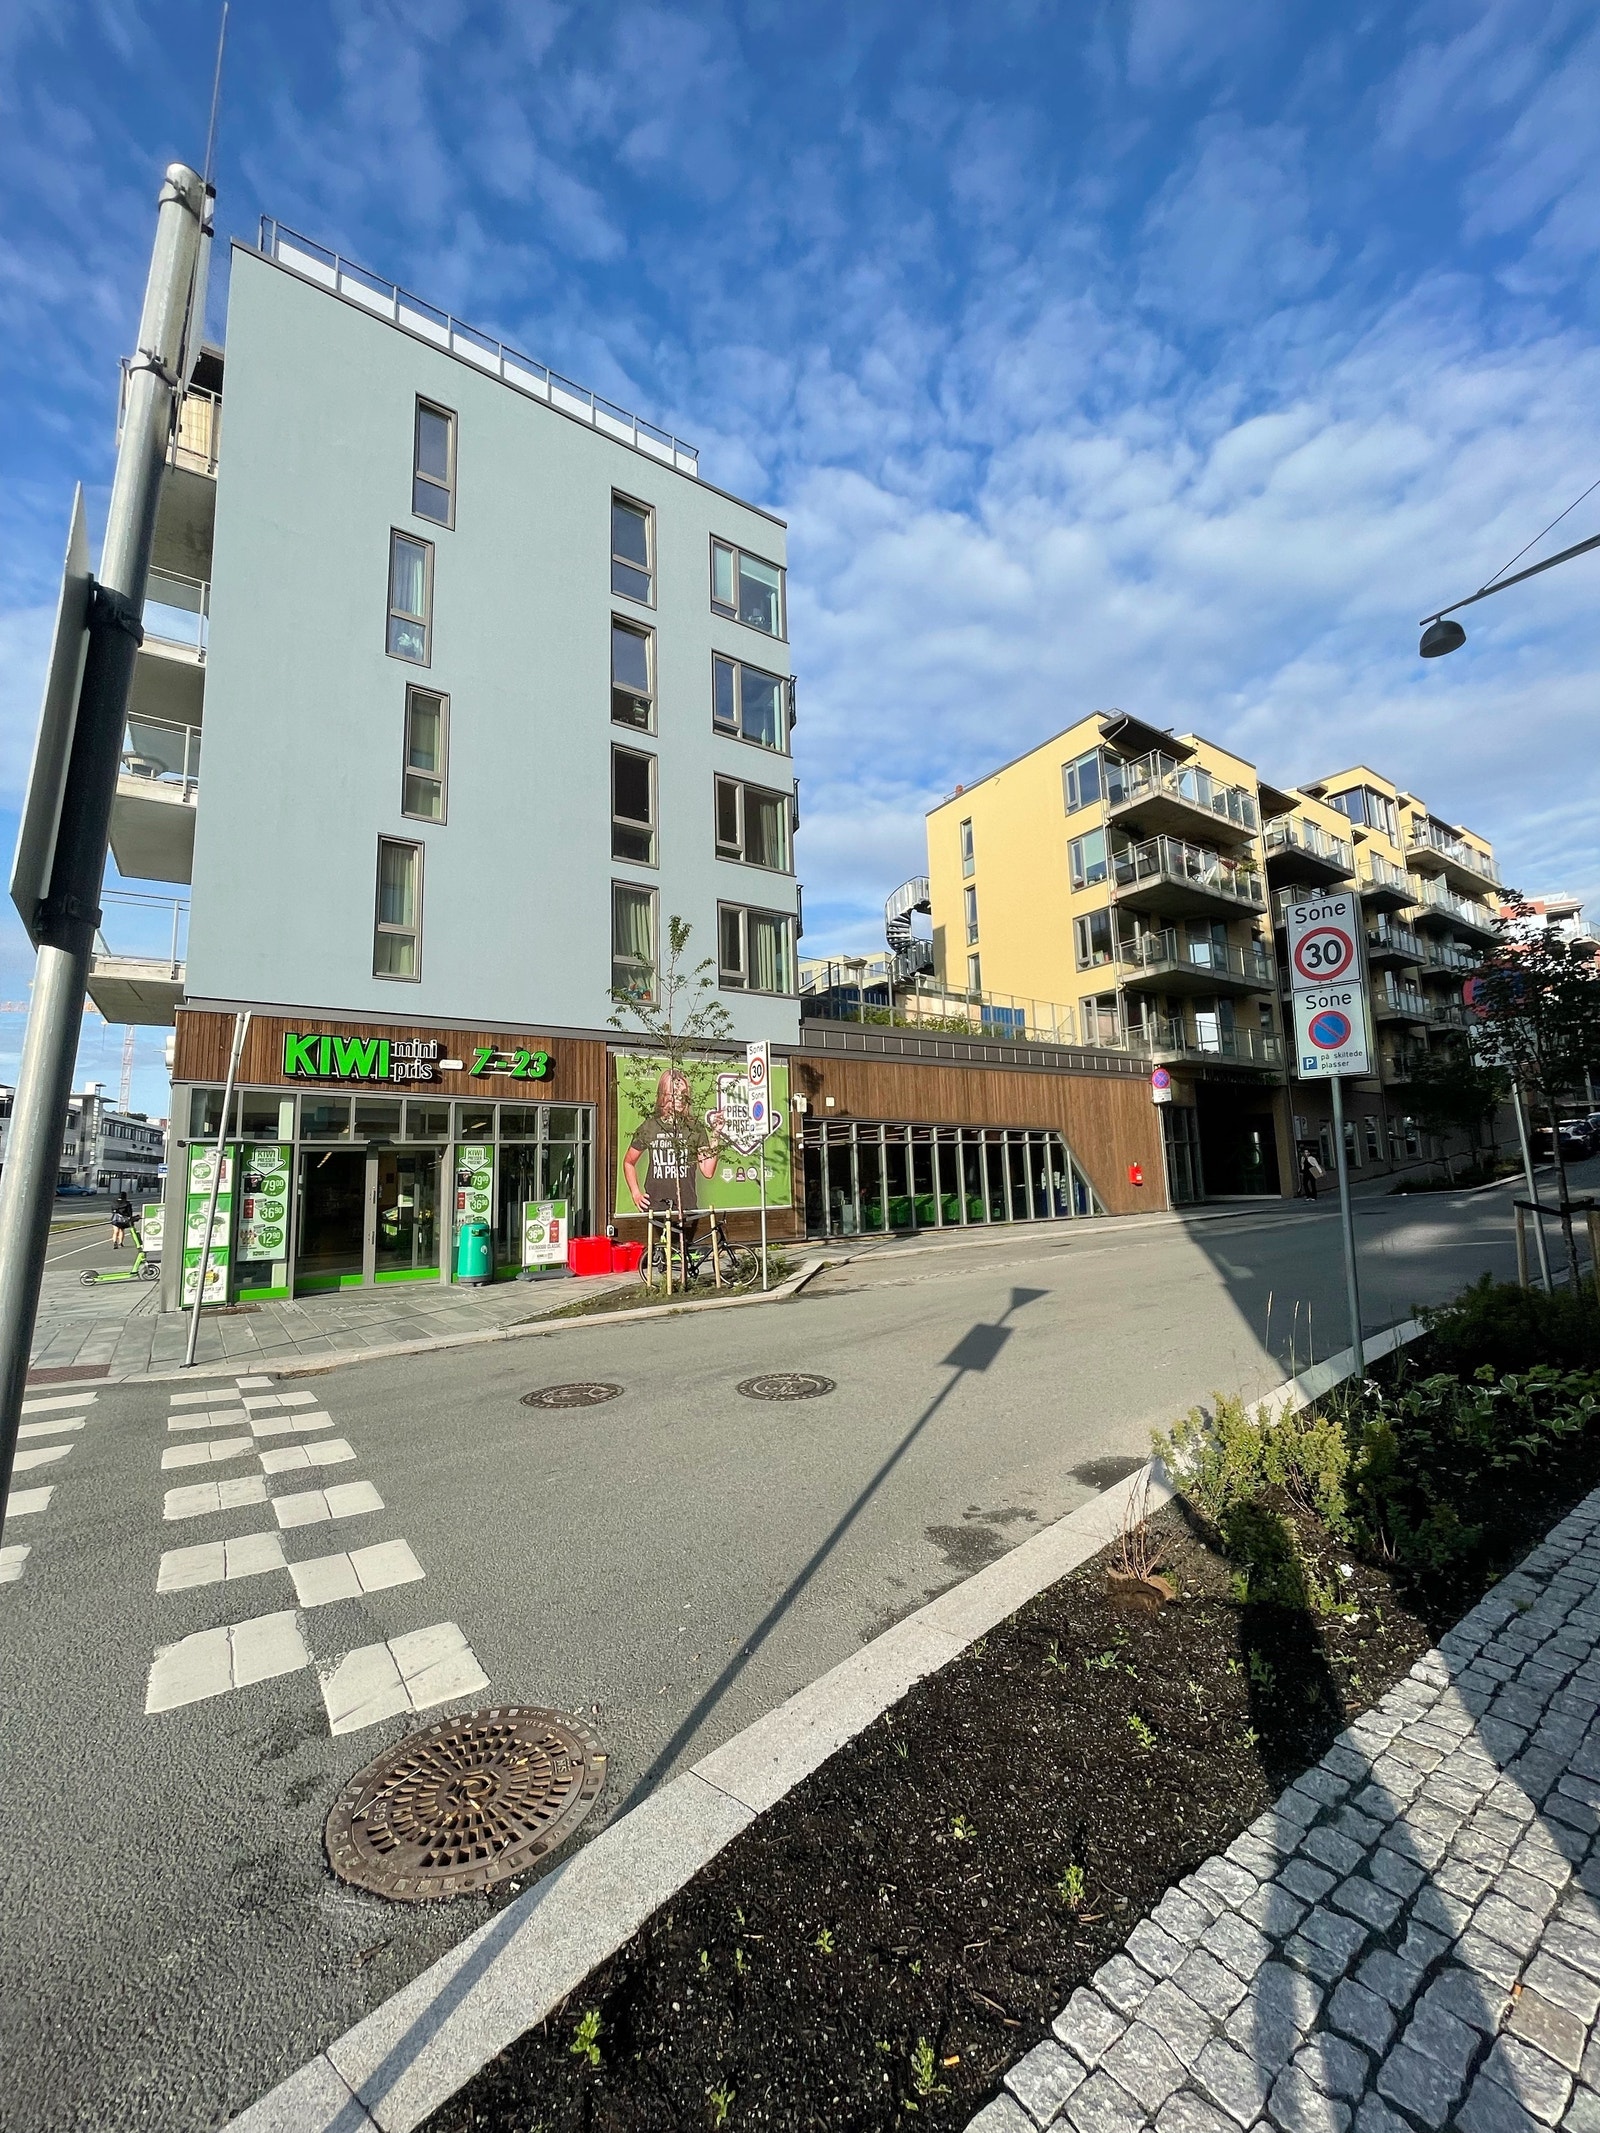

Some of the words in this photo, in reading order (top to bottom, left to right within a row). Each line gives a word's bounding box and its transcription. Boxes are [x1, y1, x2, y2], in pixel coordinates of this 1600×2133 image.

[1294, 902, 1346, 924] Sone
[1305, 940, 1342, 968] 30
[1305, 993, 1352, 1010] Sone
[284, 1032, 390, 1079] KIWI
[394, 1038, 438, 1059] mini
[749, 1044, 764, 1055] Sone
[1320, 1053, 1330, 1061] på
[1333, 1050, 1363, 1059] skiltede
[393, 1059, 433, 1082] pris
[751, 1064, 762, 1078] 30
[1321, 1060, 1350, 1070] plasser
[751, 1091, 765, 1101] Sone
